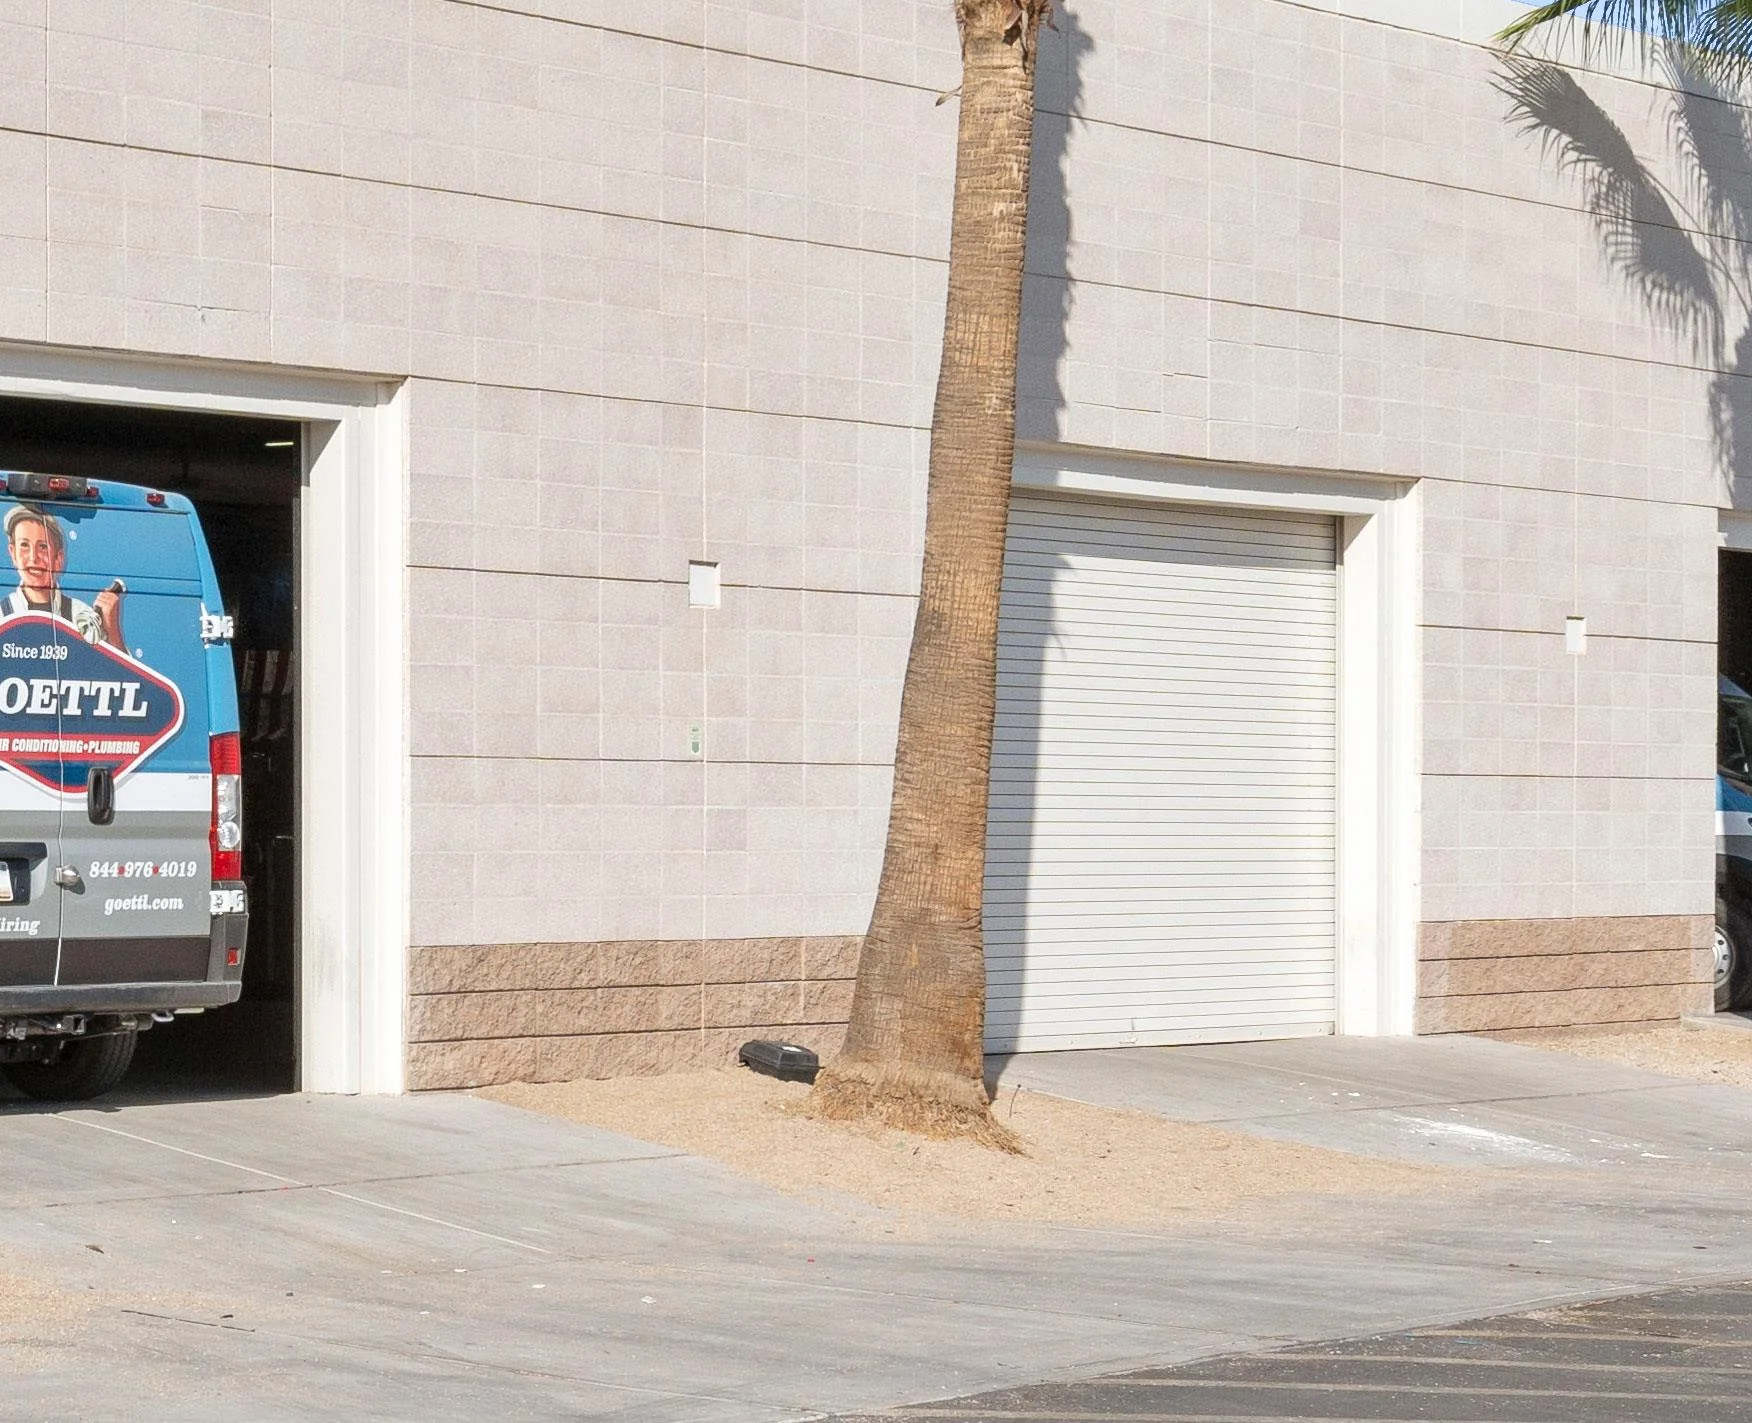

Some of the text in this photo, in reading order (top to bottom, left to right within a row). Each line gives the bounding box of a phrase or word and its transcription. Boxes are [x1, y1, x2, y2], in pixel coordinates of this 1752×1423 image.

[2, 642, 68, 661] Since 1939
[104, 893, 184, 915] goettl.com
